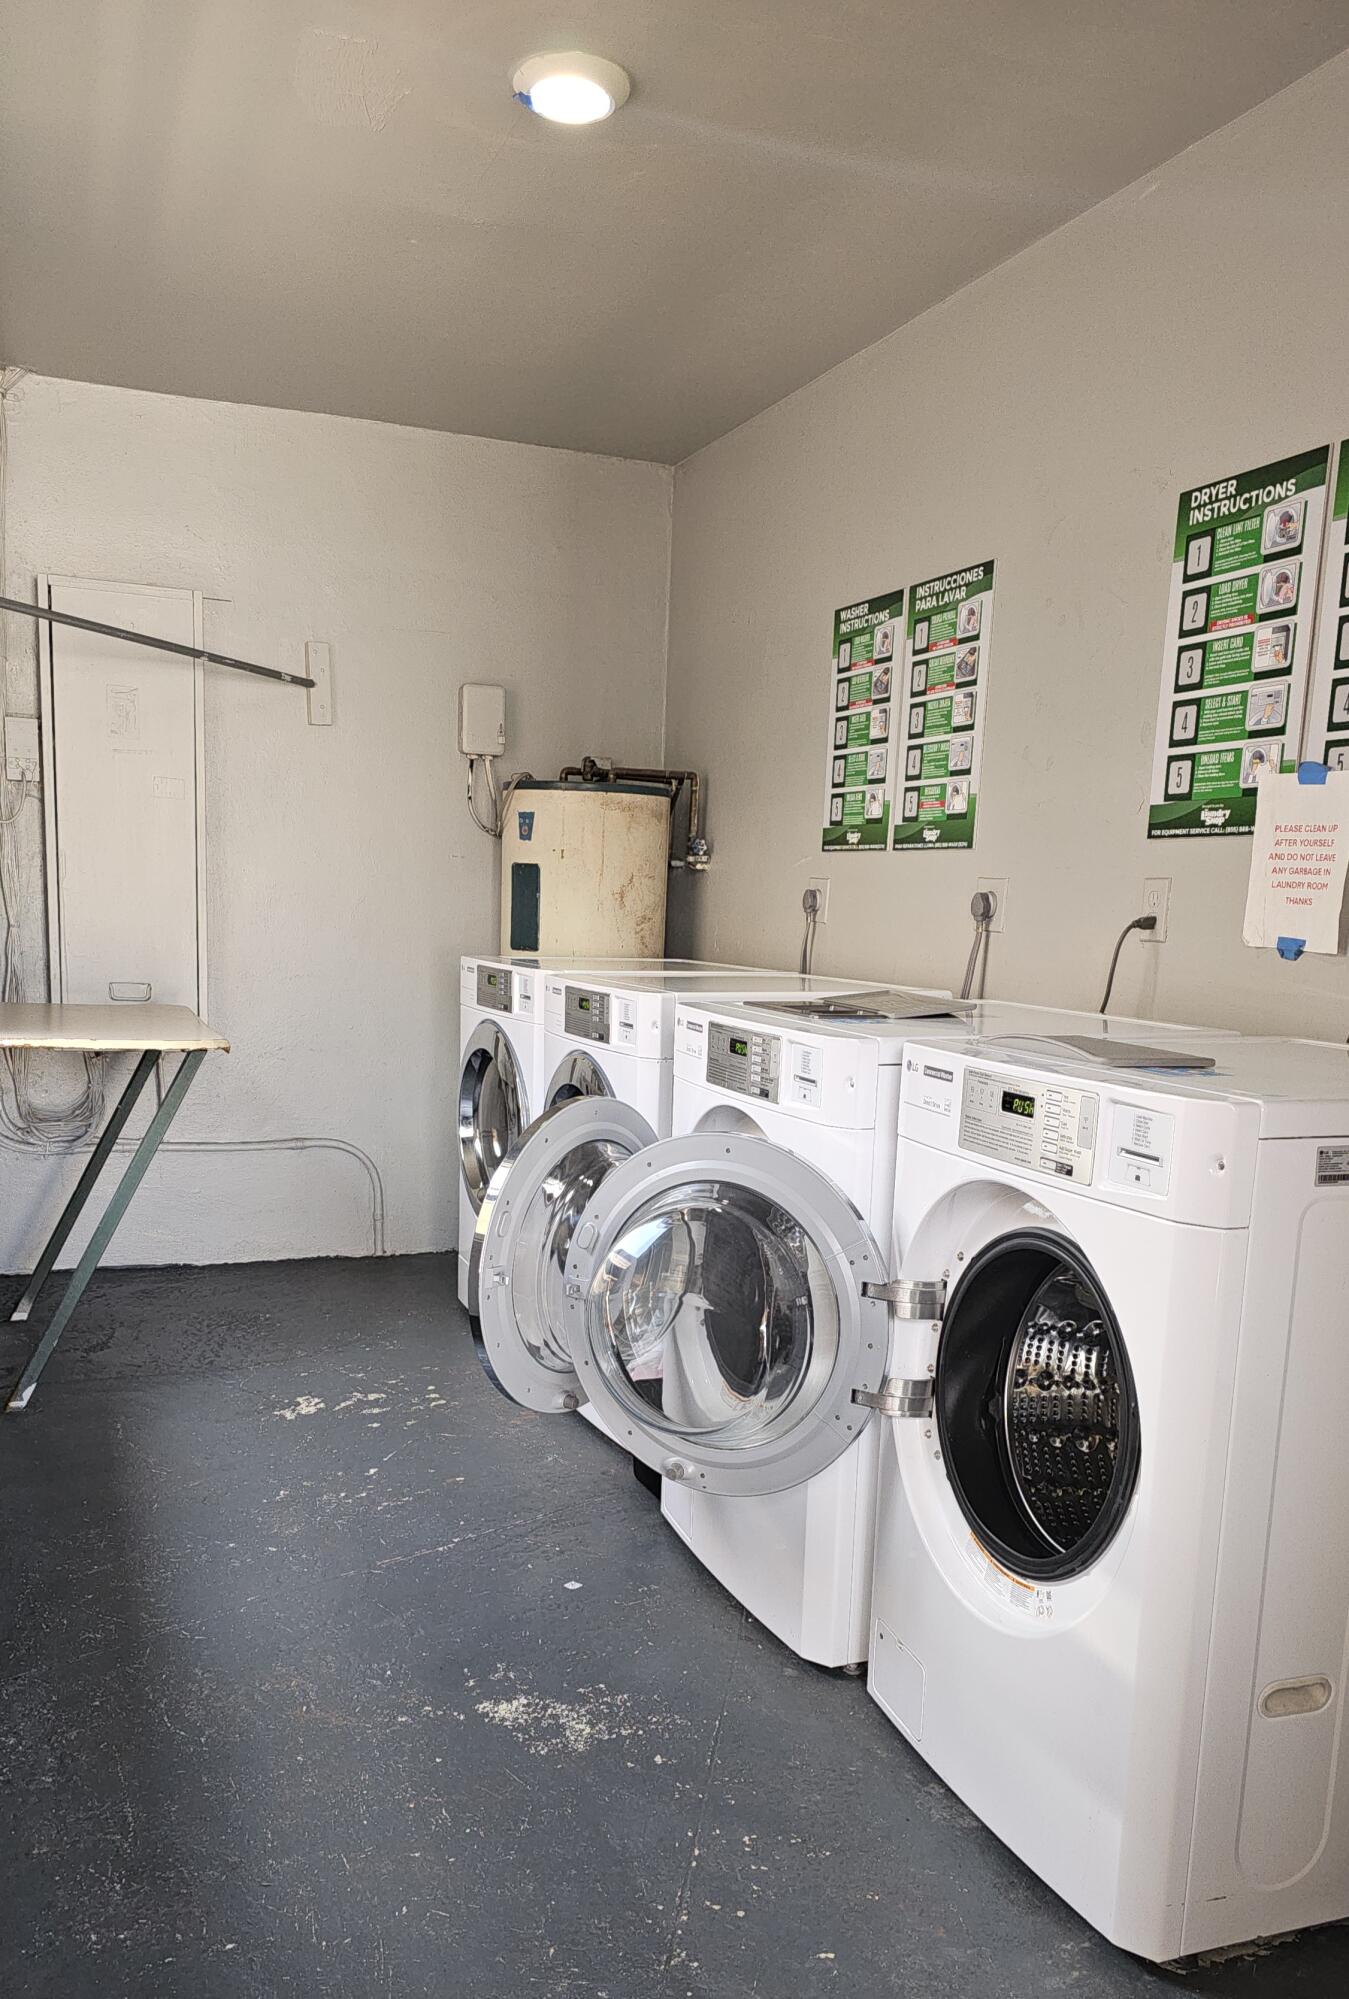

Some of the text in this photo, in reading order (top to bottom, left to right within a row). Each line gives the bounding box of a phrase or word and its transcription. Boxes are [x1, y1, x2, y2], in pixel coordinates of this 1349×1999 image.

[1189, 478, 1297, 526] INSTRUCTIONS
[1191, 479, 1237, 508] DRYER
[1216, 516, 1260, 539] CLEAN LINT FILTER
[1197, 544, 1201, 567] 1
[916, 566, 984, 598] INSTRUCCIONES
[1219, 577, 1249, 594] LOAD DRYER
[915, 586, 966, 612] PARA LAVAR
[840, 603, 869, 621] WASHER
[1192, 600, 1198, 623] 2
[840, 609, 890, 634] INSTRUCTIONS
[1212, 636, 1244, 651] INSERT CARD
[1186, 656, 1194, 679] 3
[917, 669, 921, 687] 2
[841, 686, 846, 702] 2
[1205, 696, 1220, 709] SELECT
[1227, 694, 1242, 706] START
[914, 711, 919, 729] 3
[1181, 711, 1188, 733] 4
[839, 725, 844, 740] 3
[1220, 751, 1235, 763] ITEMS
[1176, 767, 1183, 788] 5
[834, 801, 839, 817] 5
[909, 795, 913, 813] 5
[1161, 828, 1189, 836] EQUIPMENT
[1274, 824, 1339, 833] PLEASE CLEAN UP
[1274, 838, 1335, 847] AFTER YOURSELF
[1268, 853, 1337, 862] AND DO NOT LEAVE
[1271, 866, 1331, 876] ANY GARBAGE IN
[1271, 881, 1329, 890] LAUNDRY ROOM
[1285, 897, 1313, 906] THANKS
[912, 1062, 919, 1073] LG
